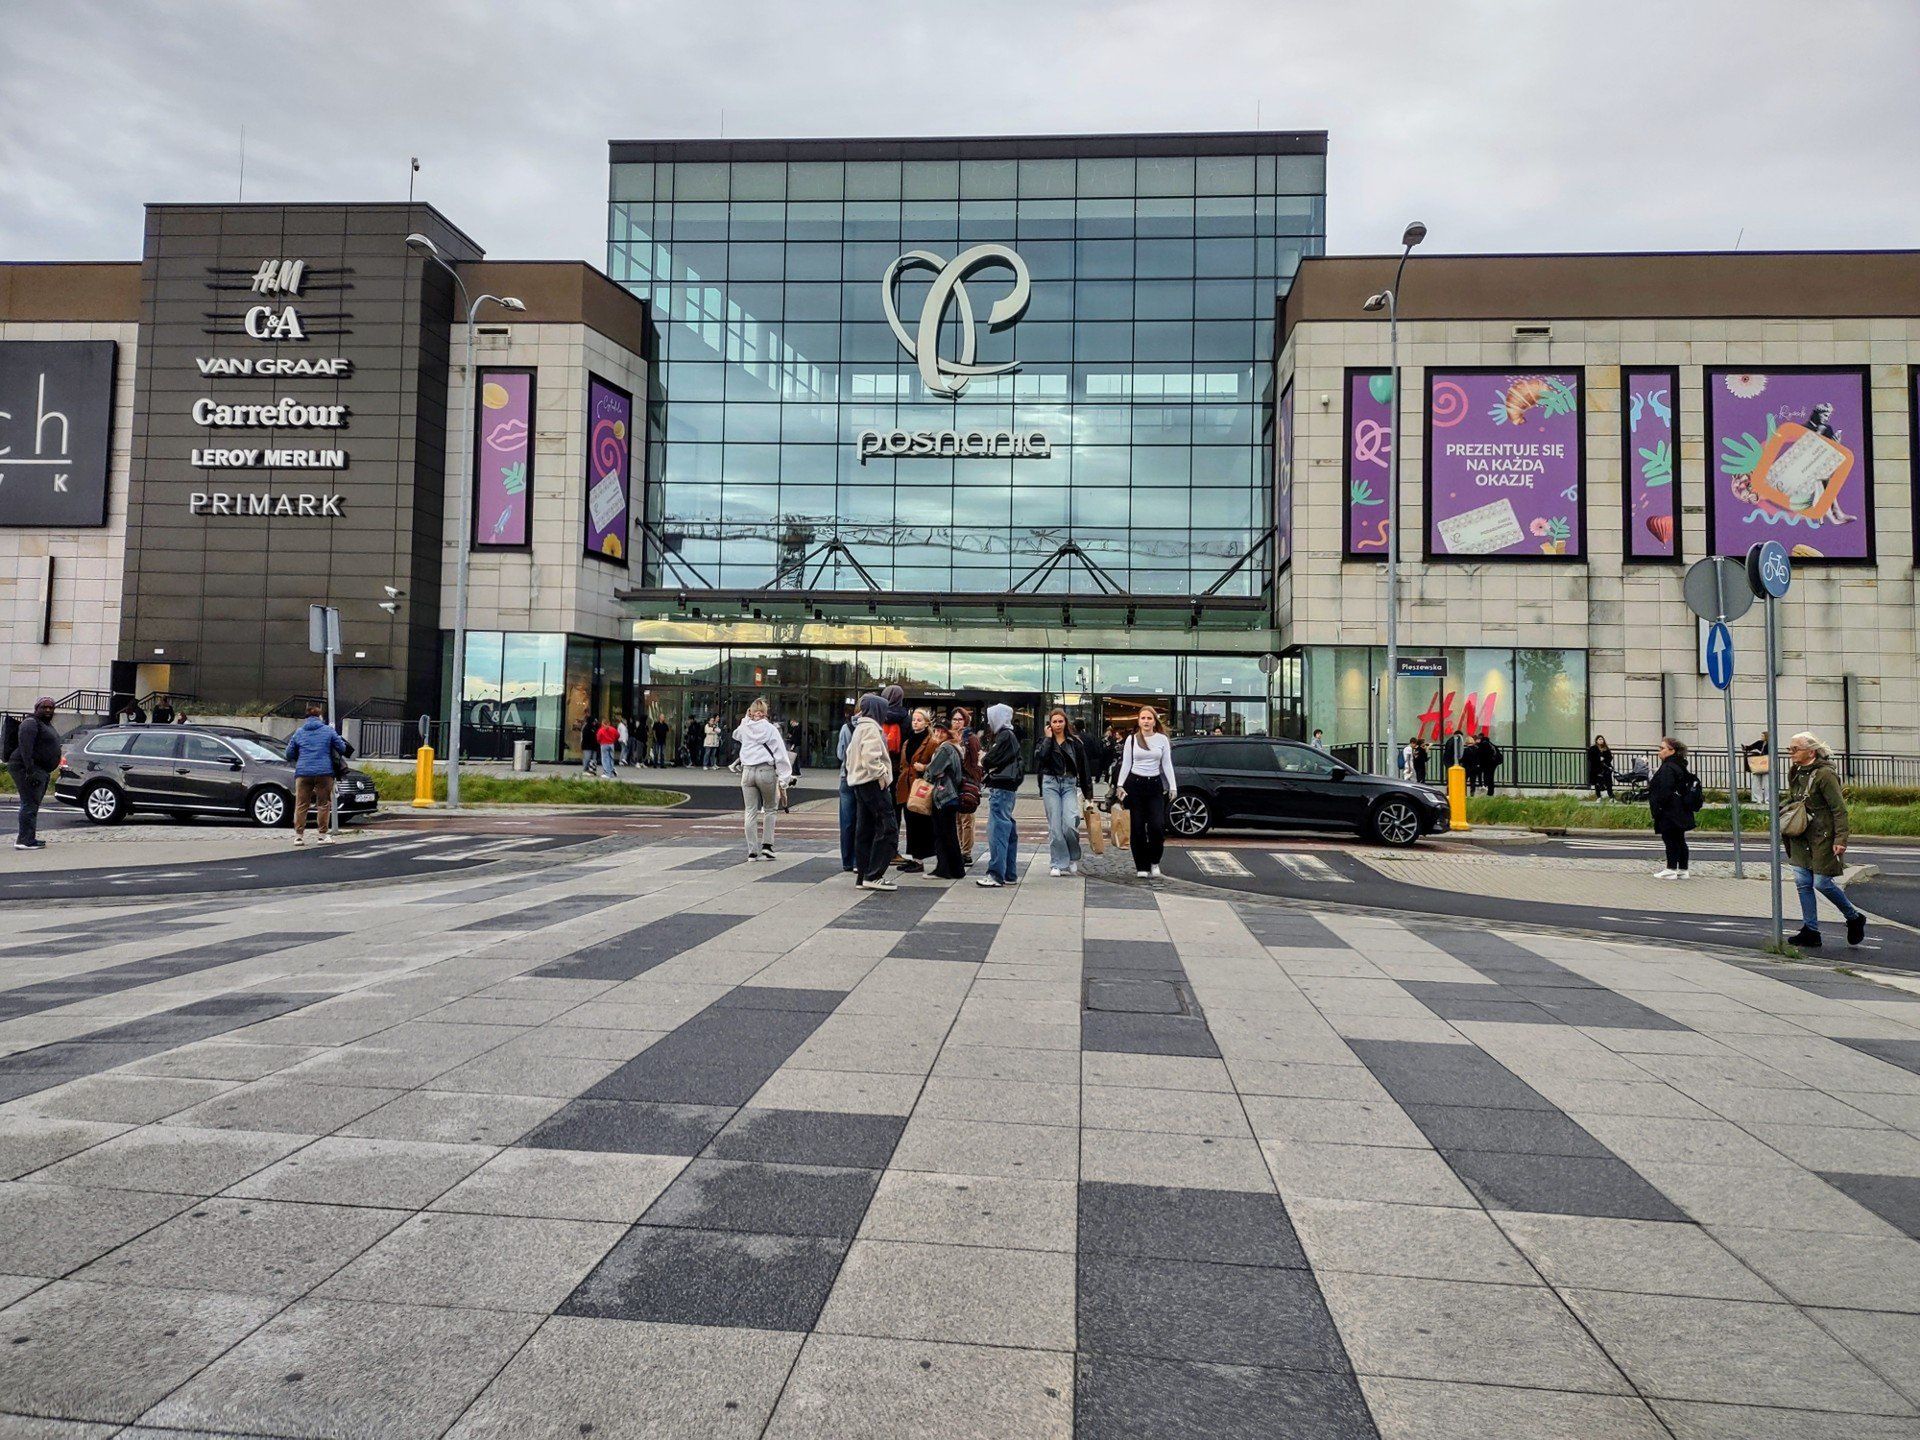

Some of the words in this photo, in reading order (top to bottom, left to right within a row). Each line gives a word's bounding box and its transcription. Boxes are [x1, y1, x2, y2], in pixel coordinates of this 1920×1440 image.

[252, 259, 305, 295] H&M
[244, 305, 305, 339] C&A
[195, 358, 253, 375] VAN
[255, 358, 349, 375] GRAAF
[192, 397, 346, 426] Carrefour
[856, 428, 1051, 461] posnania
[1446, 443, 1540, 457] PREZENTUJE
[1542, 443, 1565, 459] SIĘ
[191, 448, 259, 466] LEROY
[264, 449, 345, 468] MERLIN
[1466, 459, 1489, 472] NA
[1491, 456, 1545, 474] KAŻDĄ
[1475, 474, 1534, 489] OKAZJĘ
[189, 492, 341, 516] PRIMARK
[1401, 663, 1443, 671] Pleszewska
[470, 702, 523, 727] C&A
[1417, 691, 1498, 742] H&M
